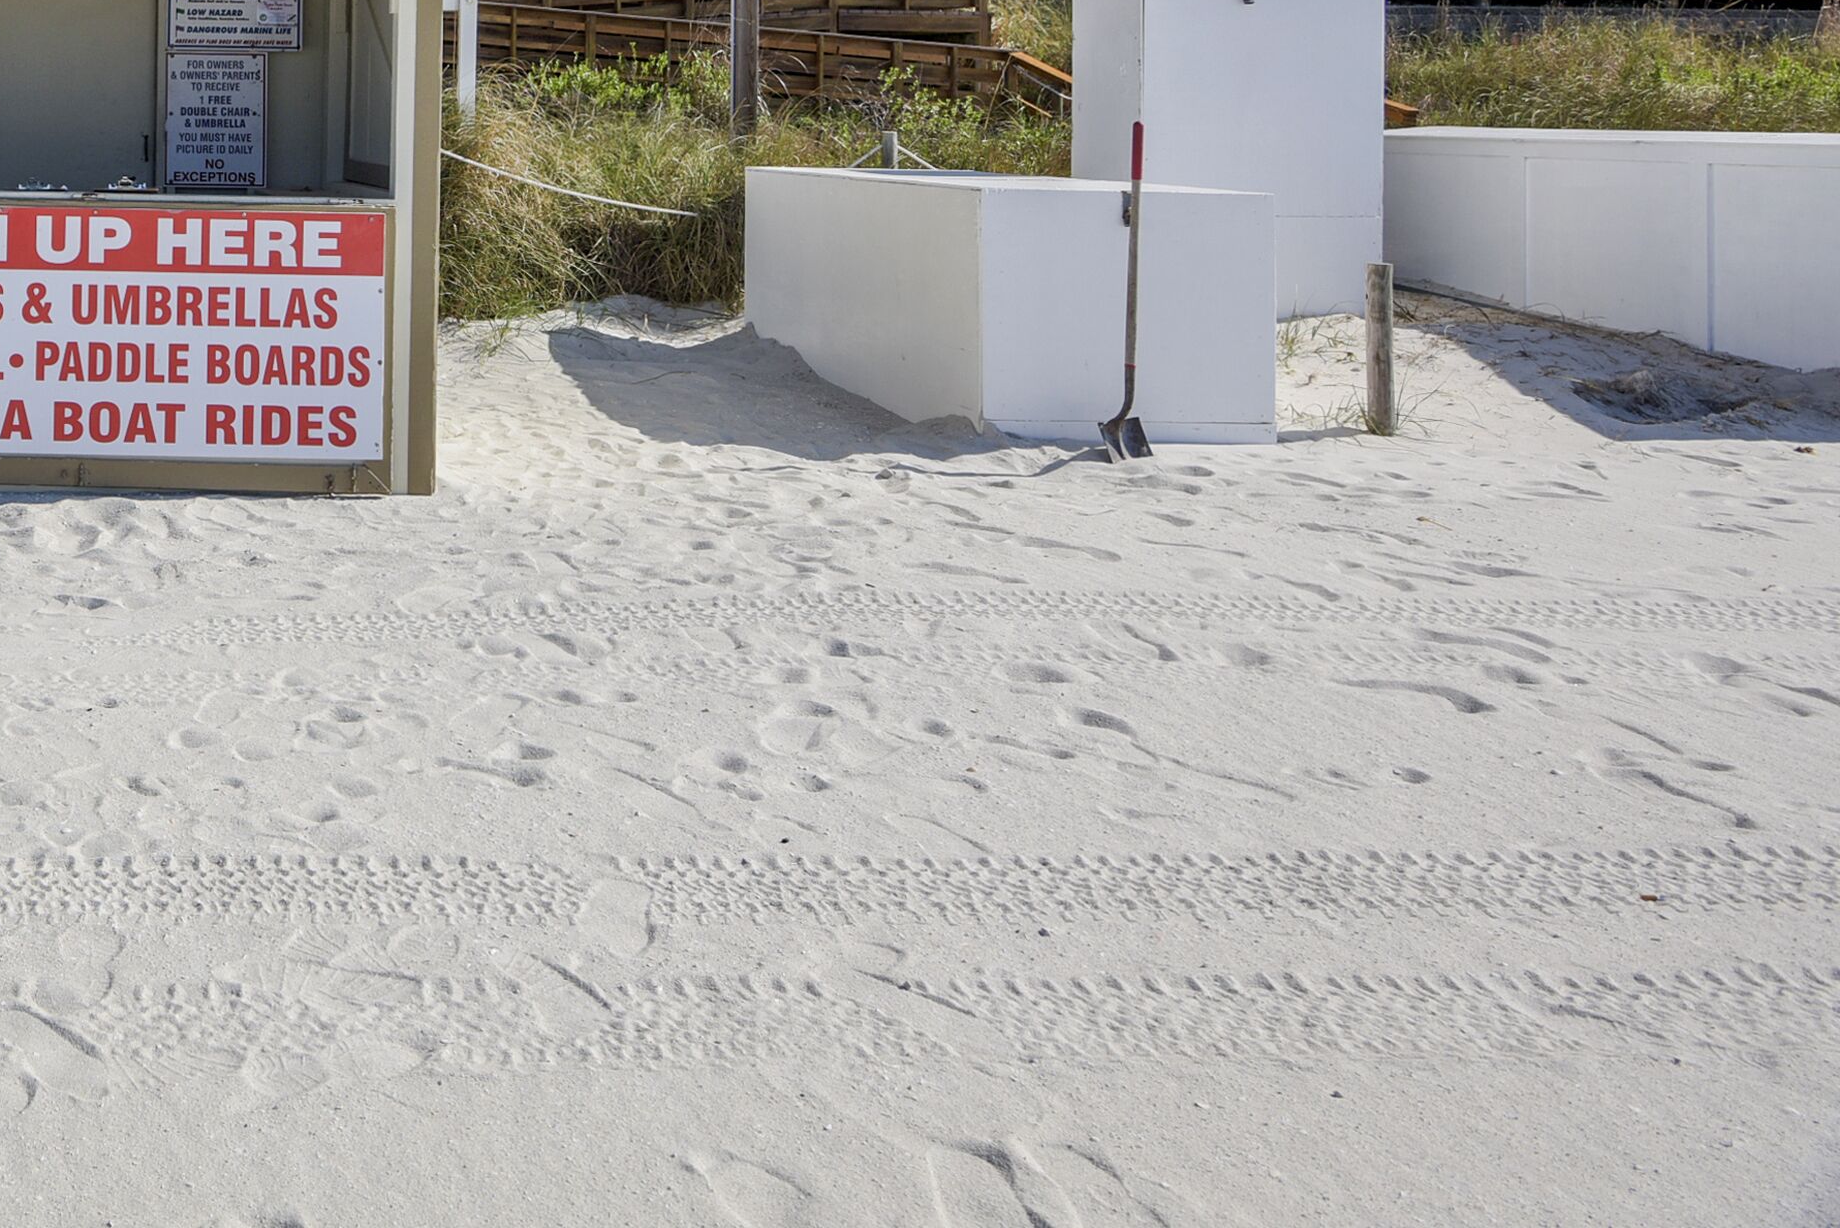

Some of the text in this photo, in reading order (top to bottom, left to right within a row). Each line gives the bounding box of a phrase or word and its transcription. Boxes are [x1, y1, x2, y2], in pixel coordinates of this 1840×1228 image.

[187, 60, 244, 69] FOR OWNERS
[171, 71, 261, 80] & OWNERS' PARENTS
[191, 82, 240, 91] TO RECEIVE
[200, 96, 232, 105] 1 FREE
[180, 107, 250, 116] DOUBLE CHAIR
[184, 119, 246, 128] & UMBRELLA
[179, 133, 252, 142] YOU MUST HAVE
[176, 145, 253, 154] PICTURE ID DAILY
[205, 159, 224, 169] NO
[174, 172, 256, 182] EXCEPTIONS
[35, 215, 132, 264] UP
[157, 218, 342, 268] HERE
[22, 283, 52, 324] &
[72, 284, 337, 329] UMBRELLAS
[36, 341, 189, 384] PADDLE
[207, 344, 370, 387] BOARDS
[53, 401, 185, 444] BOAT
[206, 404, 357, 448] RIDES
